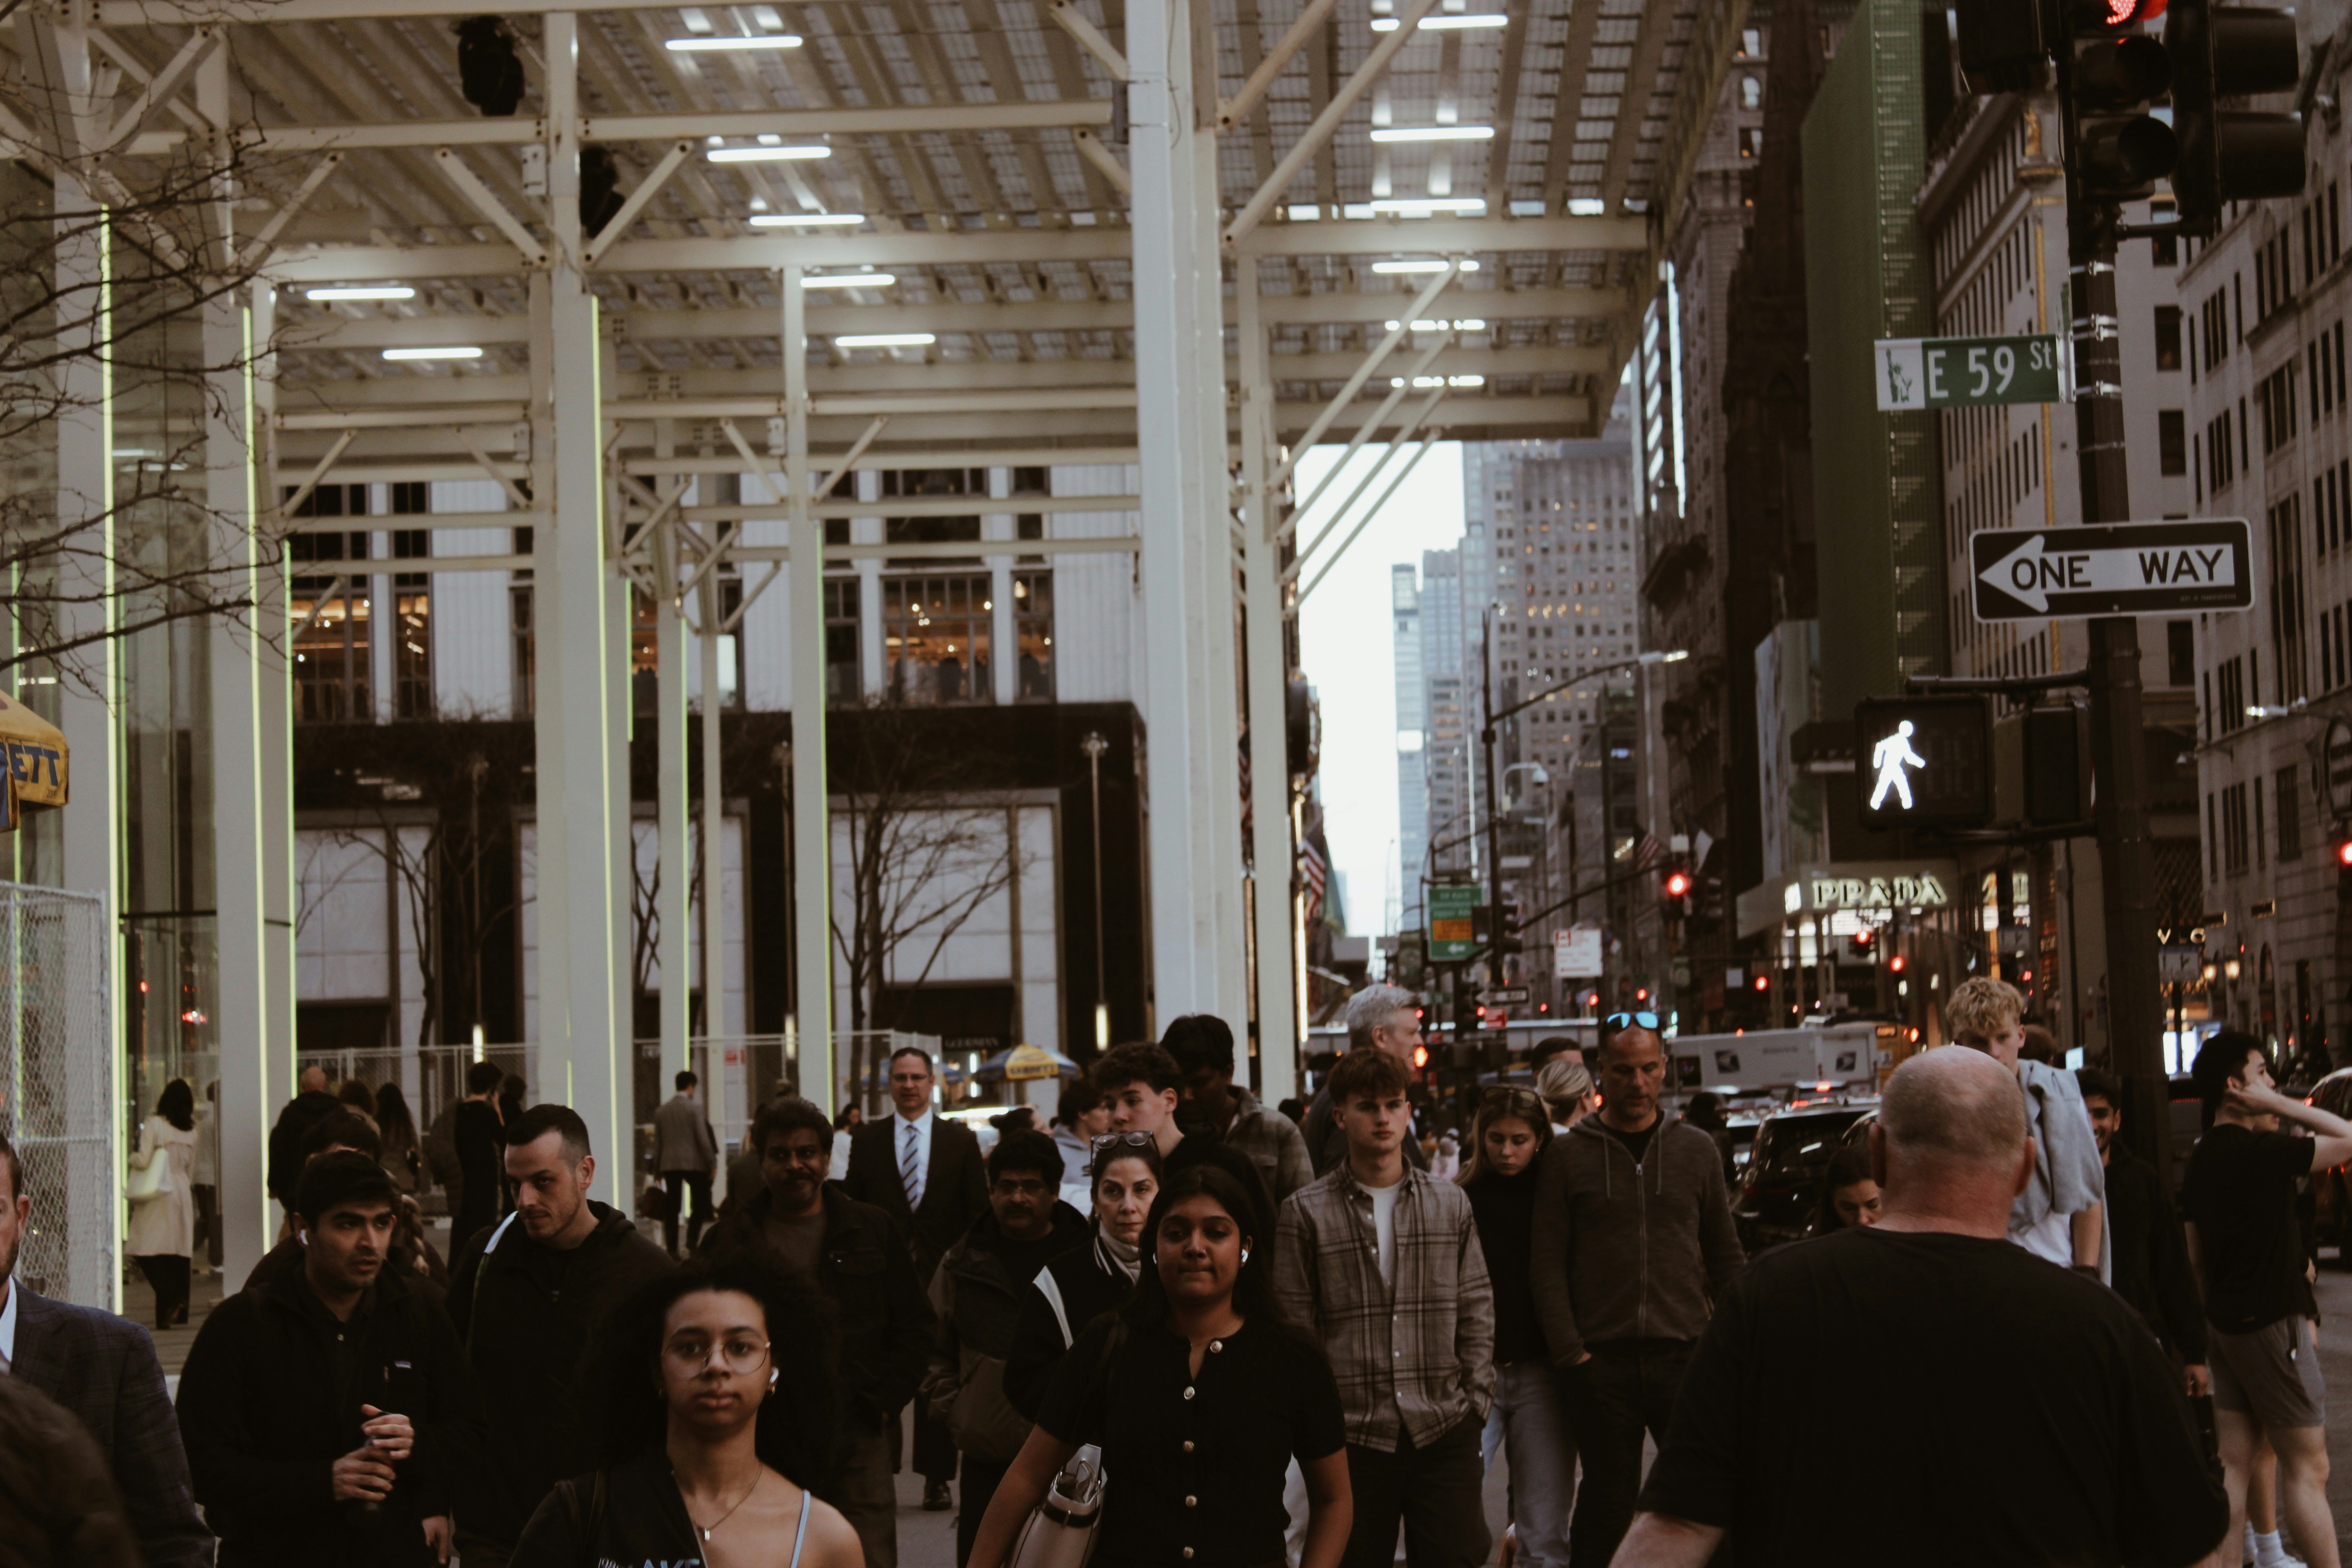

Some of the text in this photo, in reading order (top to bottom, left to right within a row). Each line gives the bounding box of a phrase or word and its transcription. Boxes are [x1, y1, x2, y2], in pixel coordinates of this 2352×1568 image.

[1927, 341, 2052, 399] E 59 St
[2011, 549, 2223, 591] ONE WAY
[1812, 875, 1947, 909] PRADA
